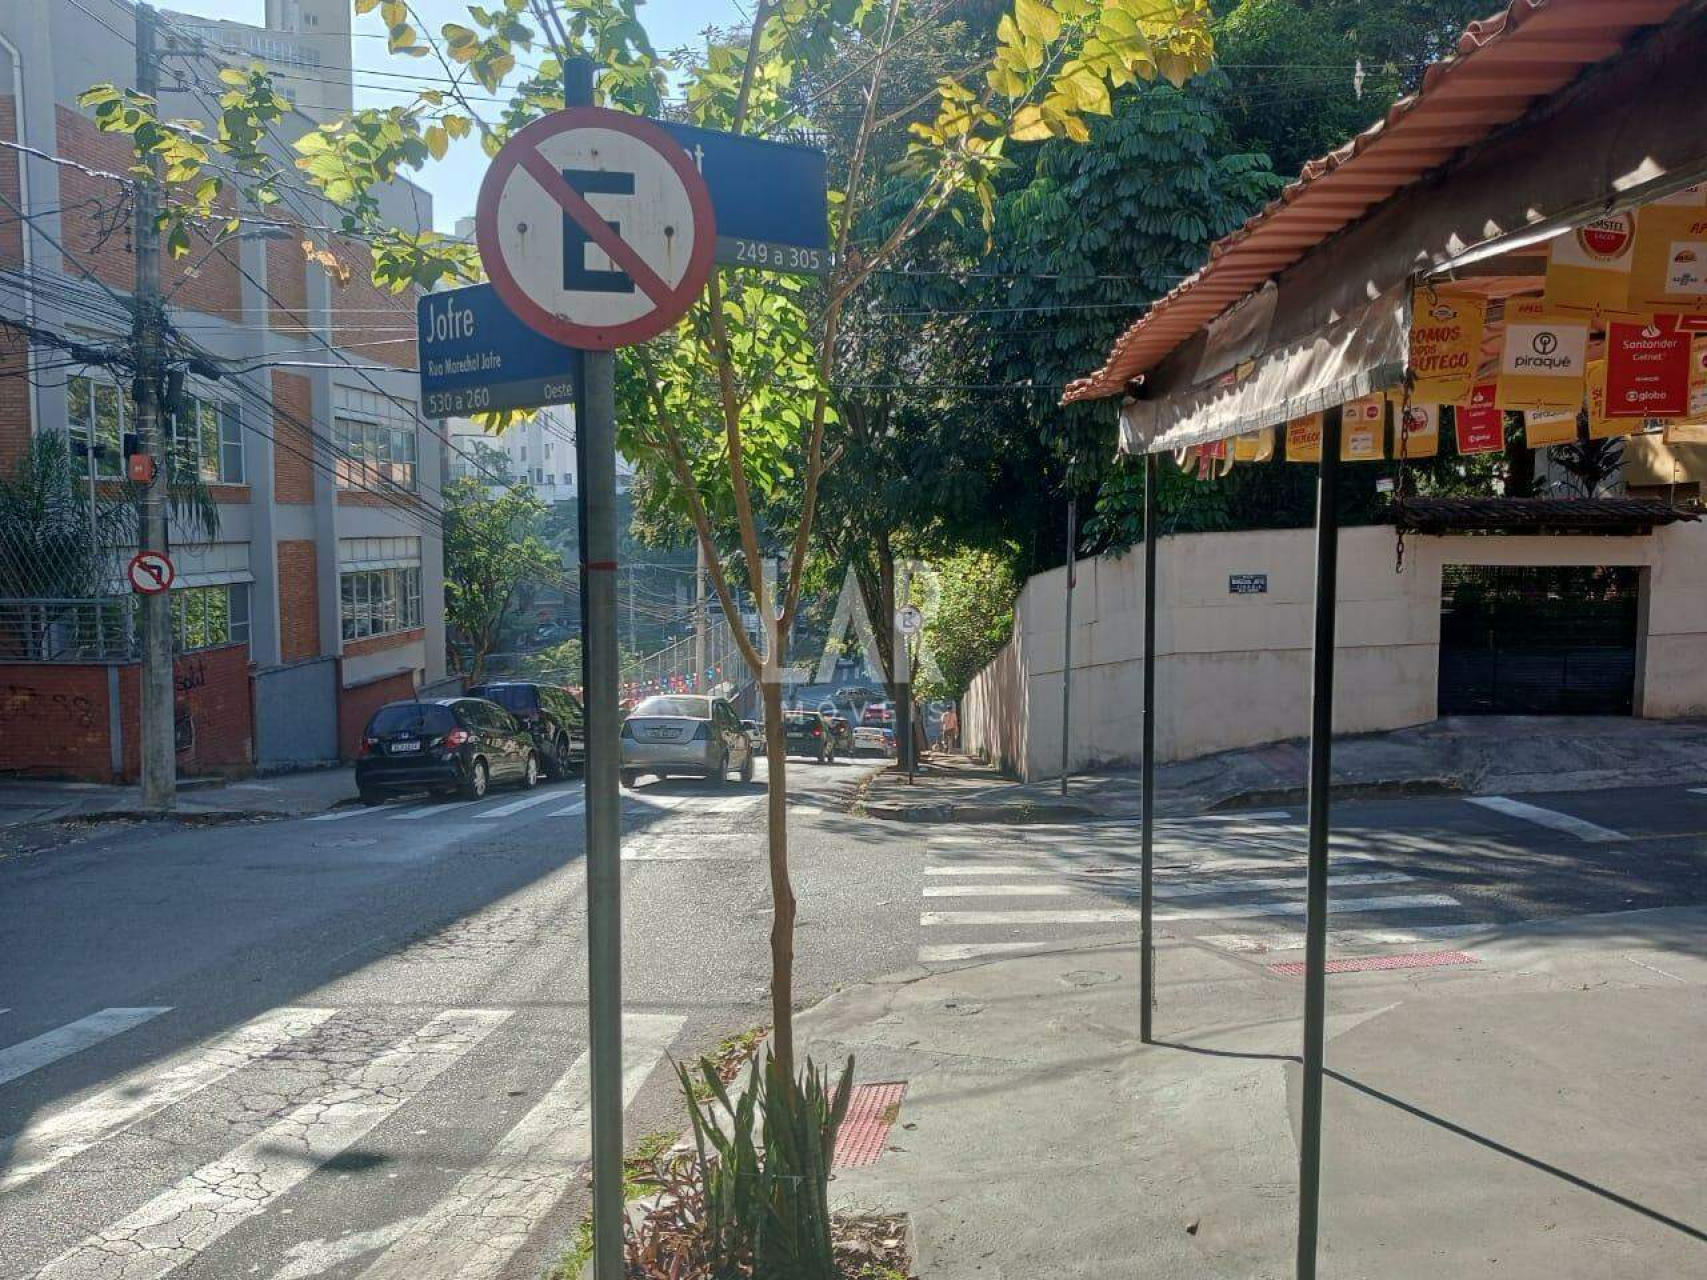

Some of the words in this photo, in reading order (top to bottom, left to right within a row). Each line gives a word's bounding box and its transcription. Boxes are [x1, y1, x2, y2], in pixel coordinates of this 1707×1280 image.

[563, 169, 635, 293] E
[1588, 218, 1624, 232] MSTEL
[736, 242, 768, 263] 249
[774, 249, 784, 265] a
[790, 248, 820, 269] 305
[426, 298, 475, 343] Jofre
[1623, 340, 1677, 350] Santander
[428, 360, 444, 377] Rua
[445, 352, 480, 374] Marechal
[481, 351, 502, 370] Jofre
[429, 393, 452, 414] 530
[455, 395, 464, 410] a
[466, 387, 489, 409] 260
[543, 384, 573, 399] Oeste
